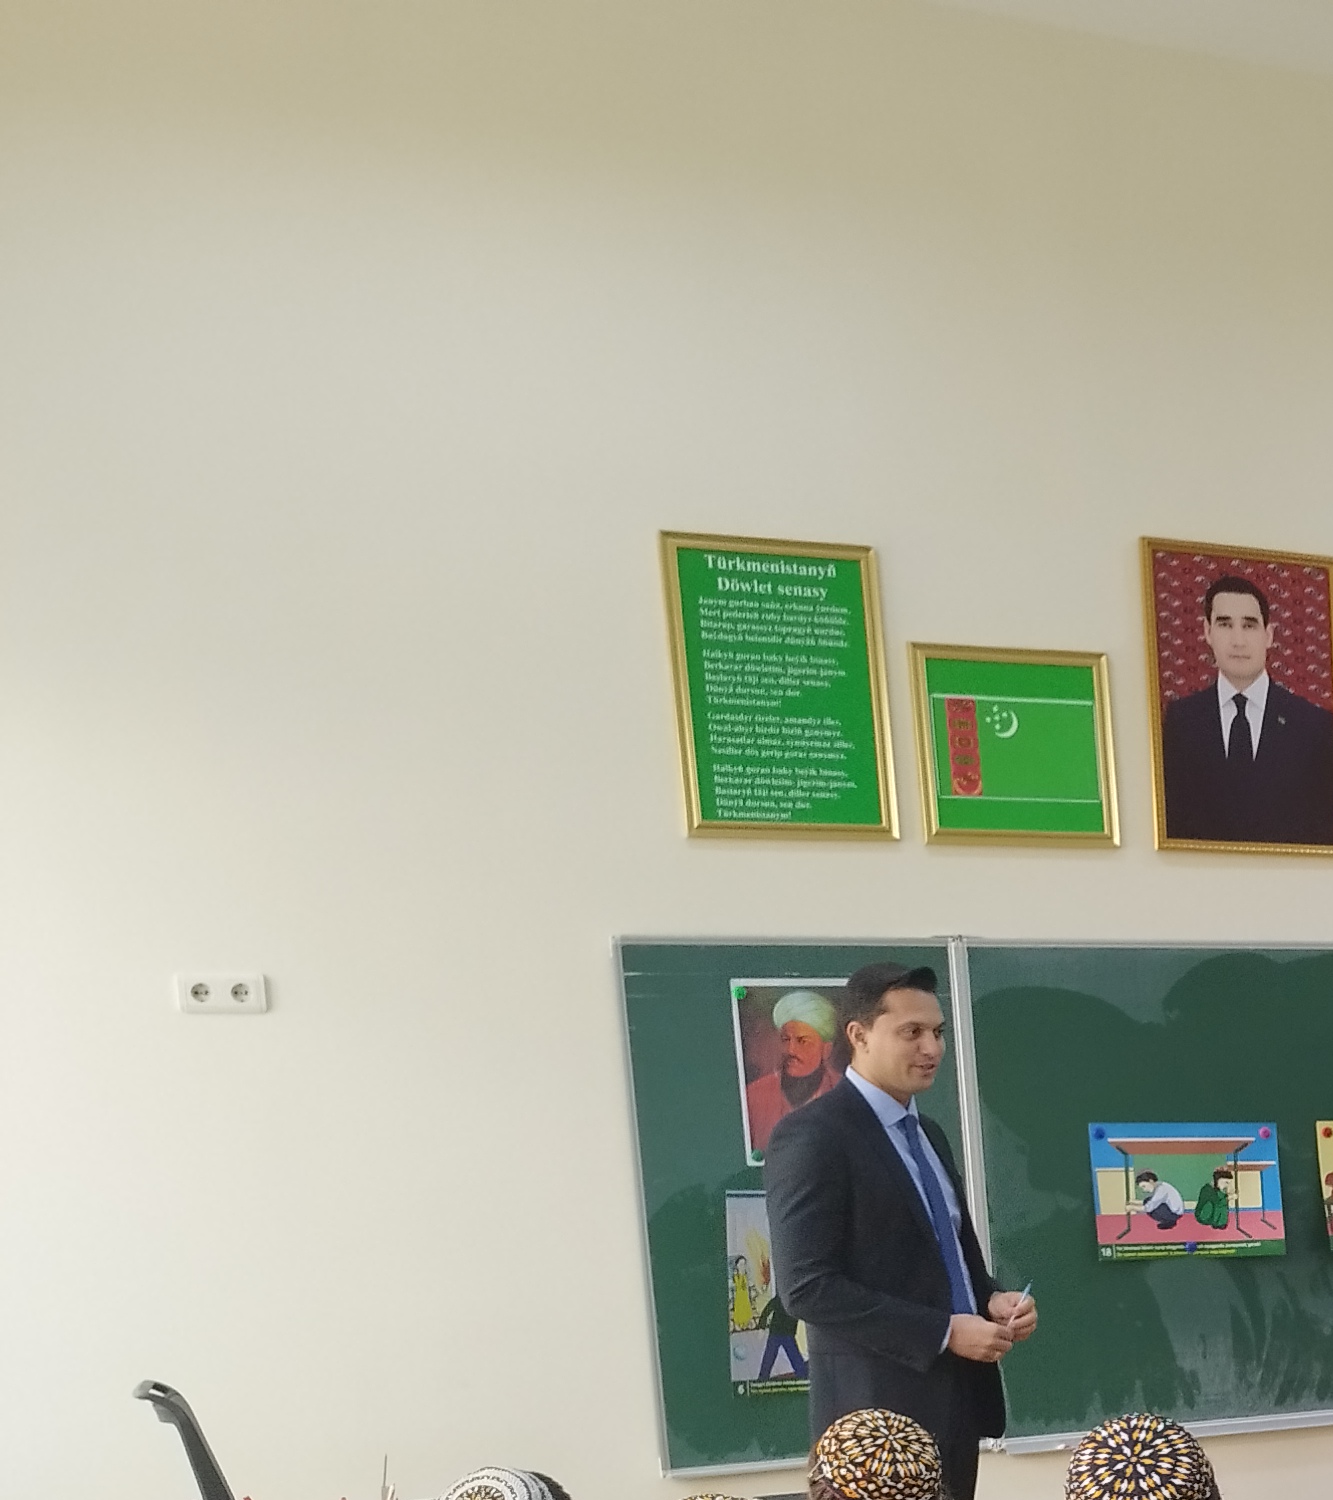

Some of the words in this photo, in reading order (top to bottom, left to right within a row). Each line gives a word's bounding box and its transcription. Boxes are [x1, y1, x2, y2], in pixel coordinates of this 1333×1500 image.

[704, 553, 837, 580] Türkmenistanyň
[717, 576, 772, 595] Döwlet
[777, 583, 828, 600] senasy
